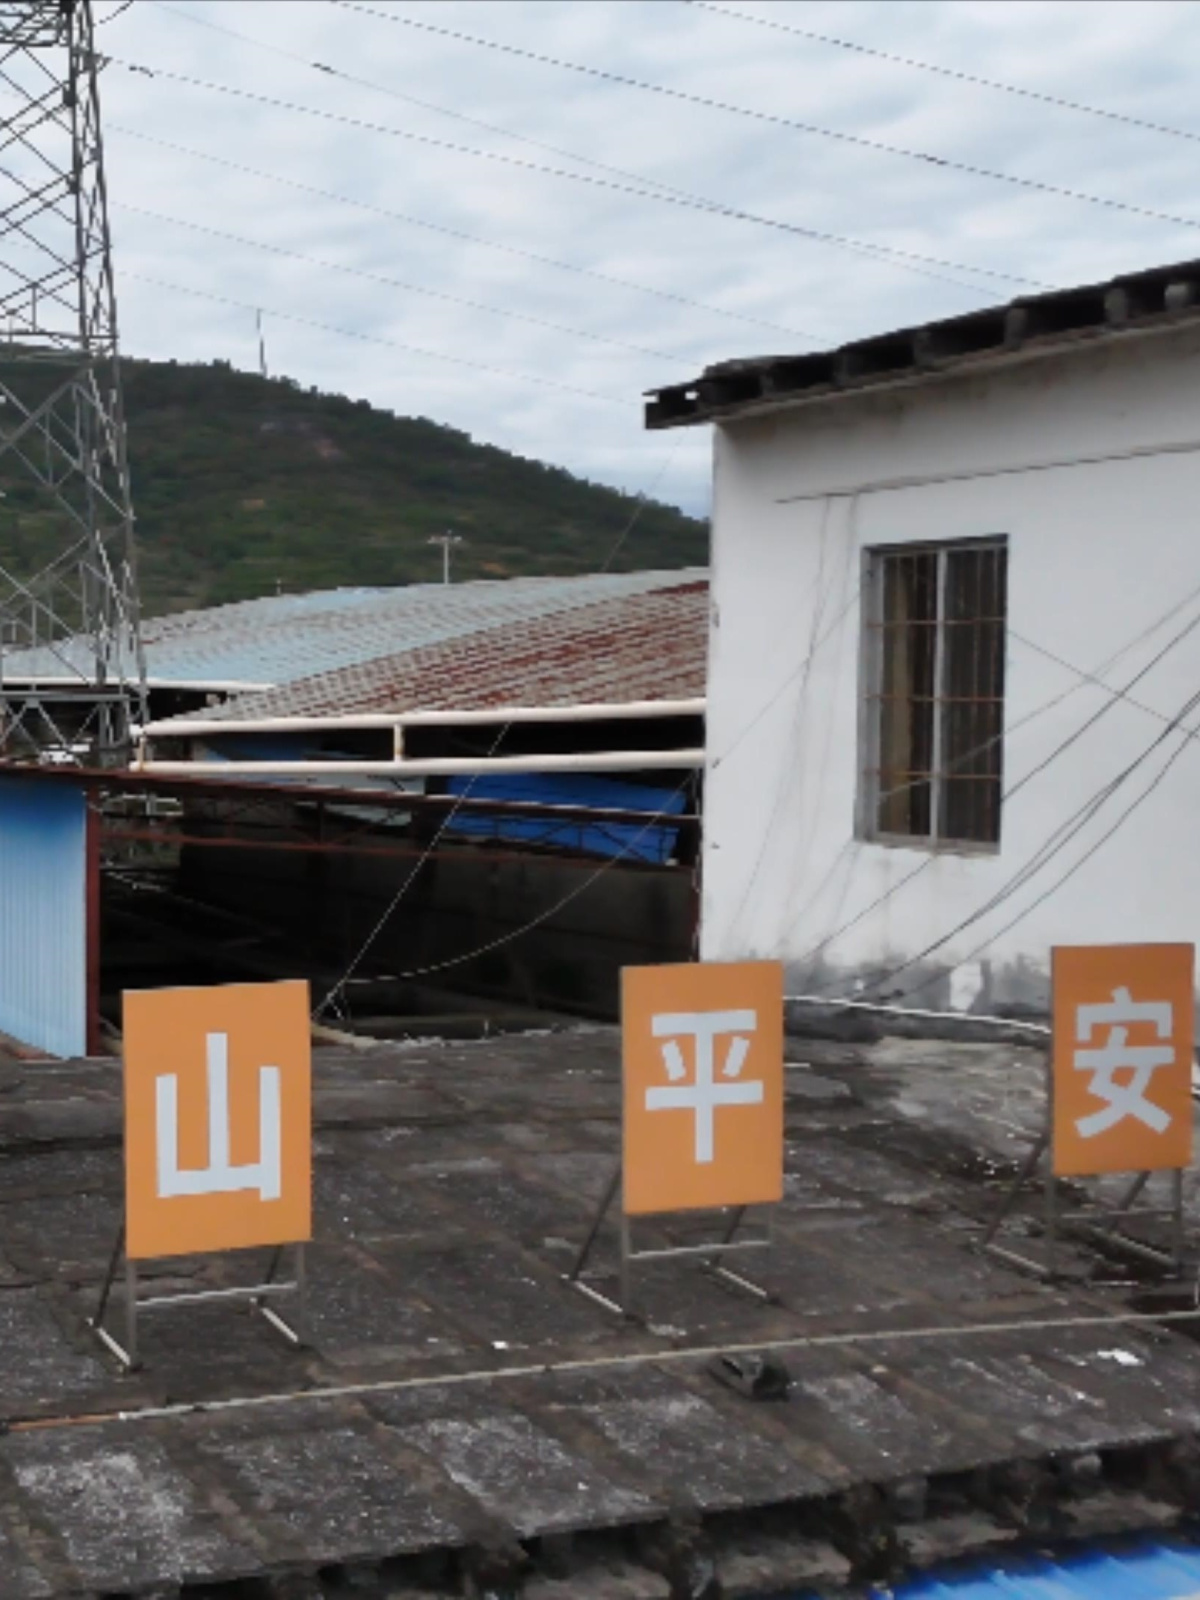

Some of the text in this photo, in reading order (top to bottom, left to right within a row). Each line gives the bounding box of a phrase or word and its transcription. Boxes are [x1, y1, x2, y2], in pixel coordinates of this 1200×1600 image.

[156, 1033, 281, 1200] 山
[645, 1010, 763, 1163] 平
[1074, 988, 1174, 1137] 安
